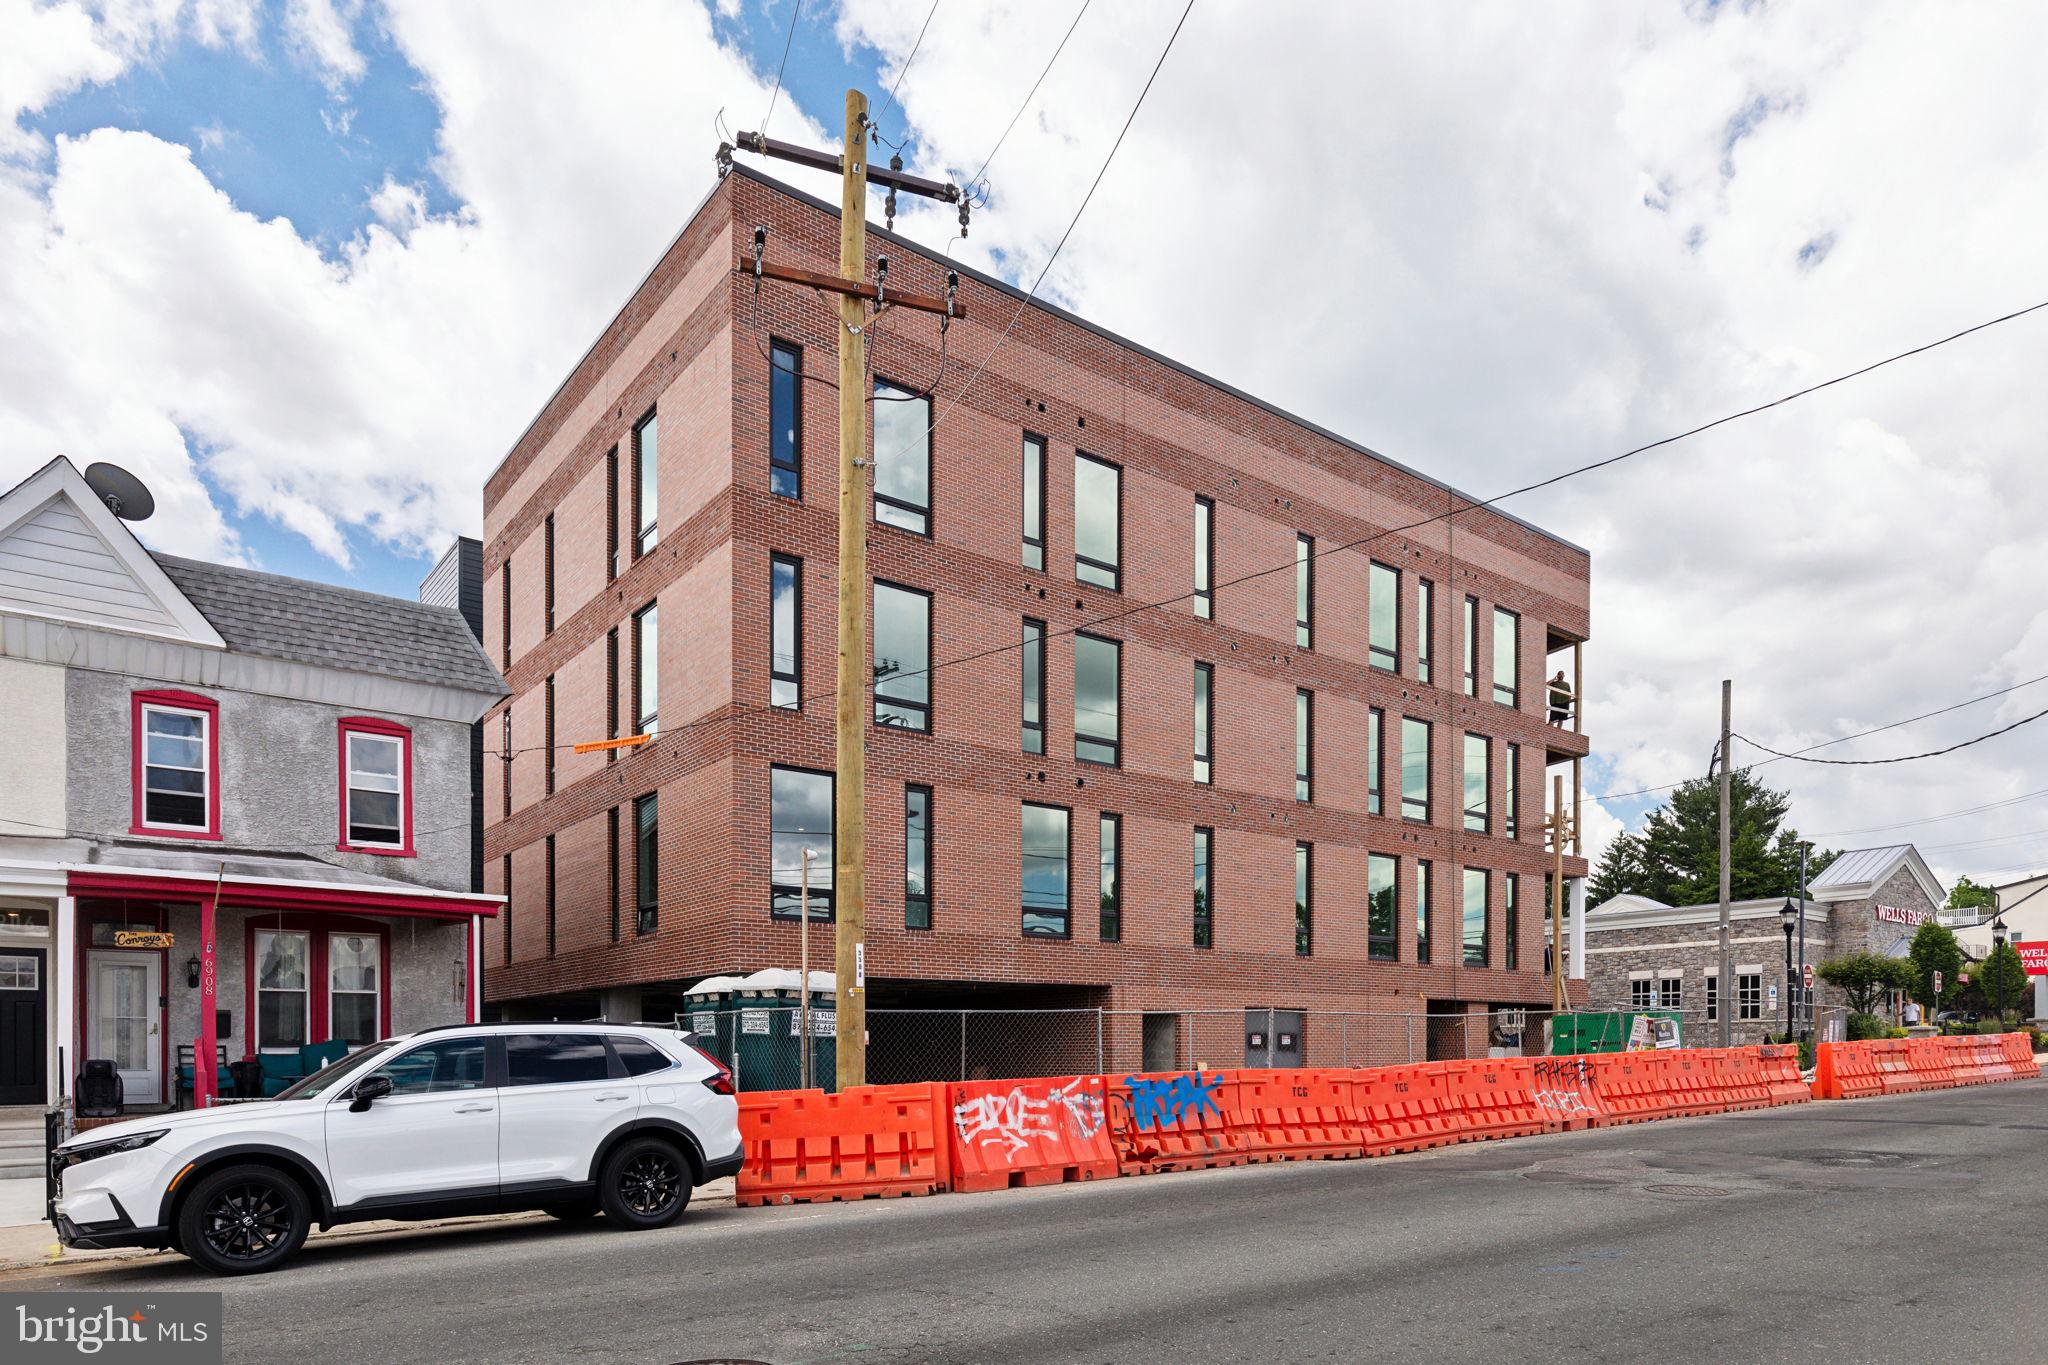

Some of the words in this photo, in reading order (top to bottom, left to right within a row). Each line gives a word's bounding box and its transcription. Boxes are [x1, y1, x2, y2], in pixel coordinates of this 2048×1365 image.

[1877, 905, 1907, 924] WELLS
[1907, 909, 1934, 926] FARGO
[205, 958, 213, 996] 6908
[1484, 1074, 1497, 1083] TCG
[1292, 1087, 1308, 1097] TCG
[1394, 1083, 1409, 1093] TCG
